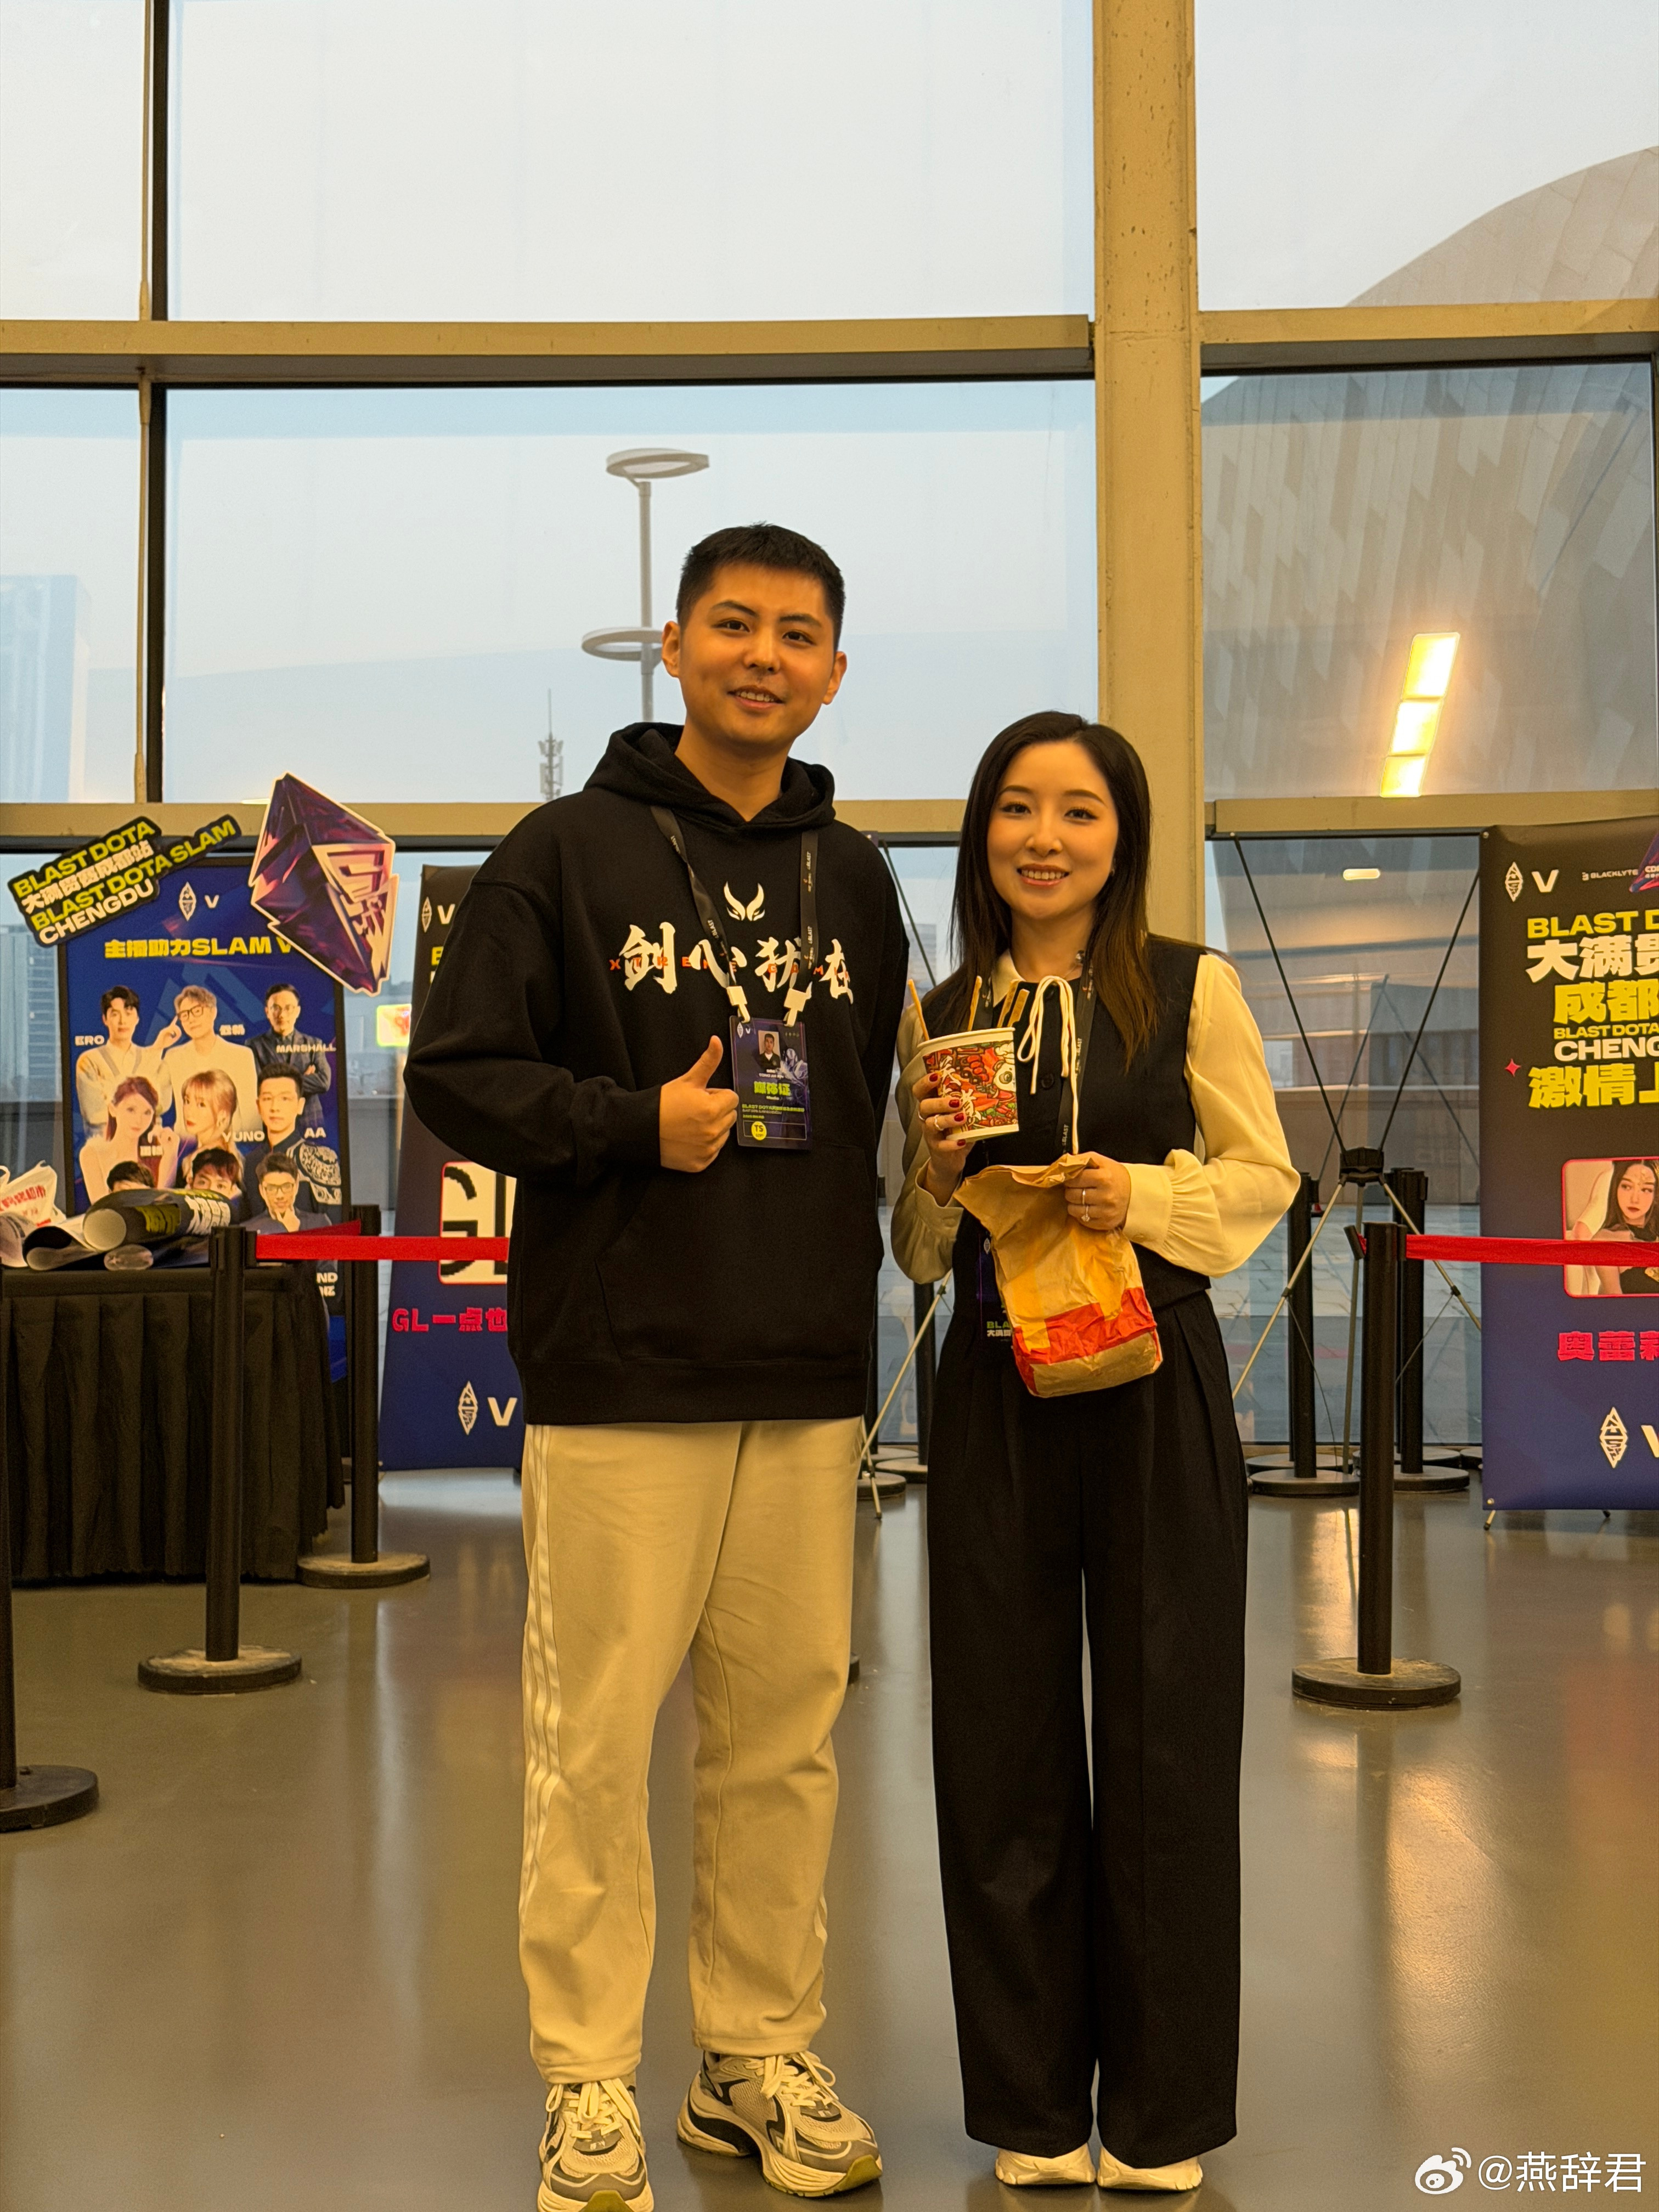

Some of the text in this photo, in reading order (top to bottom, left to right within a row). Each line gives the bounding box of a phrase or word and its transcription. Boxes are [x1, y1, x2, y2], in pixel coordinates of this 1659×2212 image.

[14, 821, 155, 898] BLAST DOTA
[31, 820, 236, 930] BLAST DOTA SLAM
[39, 878, 154, 944] CHENGDU
[1527, 911, 1639, 939] BLAST
[1554, 1023, 1659, 1039] BLAST DOTA
[222, 1130, 265, 1143] YUNO
[304, 1127, 326, 1138] AA
